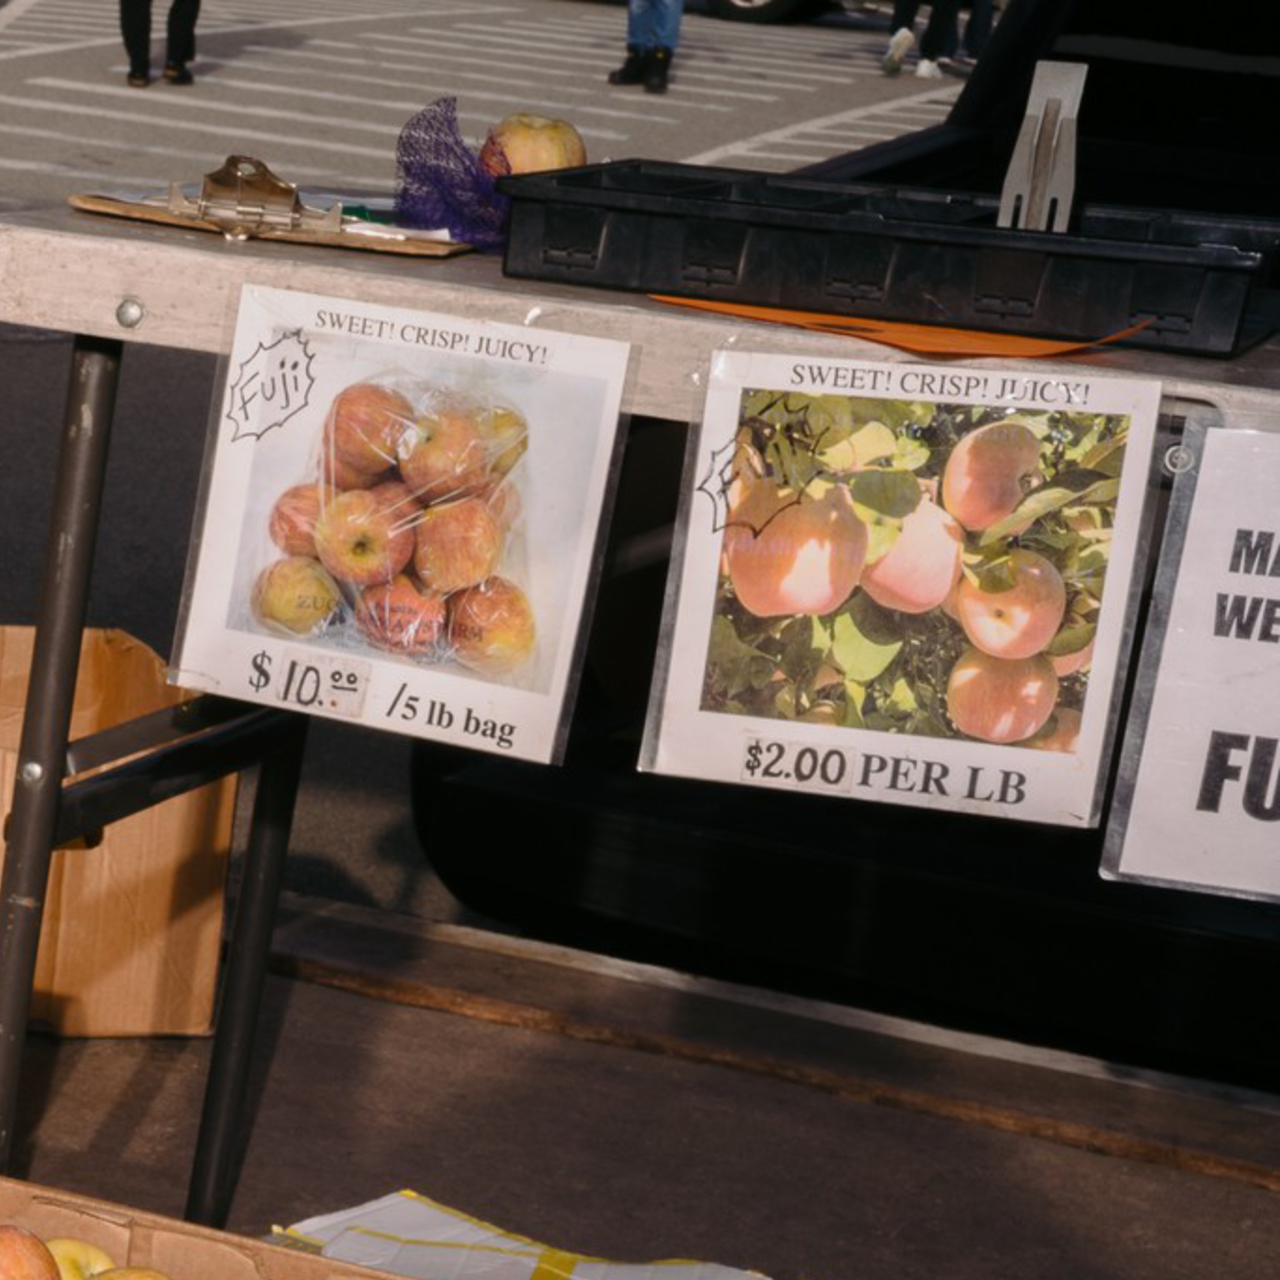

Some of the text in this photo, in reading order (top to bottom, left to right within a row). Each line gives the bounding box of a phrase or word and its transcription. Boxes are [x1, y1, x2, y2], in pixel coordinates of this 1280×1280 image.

[315, 309, 548, 365] SWEET! CRISP! JUICY!
[238, 357, 299, 421] Fuji
[790, 363, 1091, 404] SWEET! CRISP! JUICY!
[427, 700, 454, 729] lb
[463, 708, 517, 749] bag
[745, 740, 1026, 805] $2.00 PER LB
